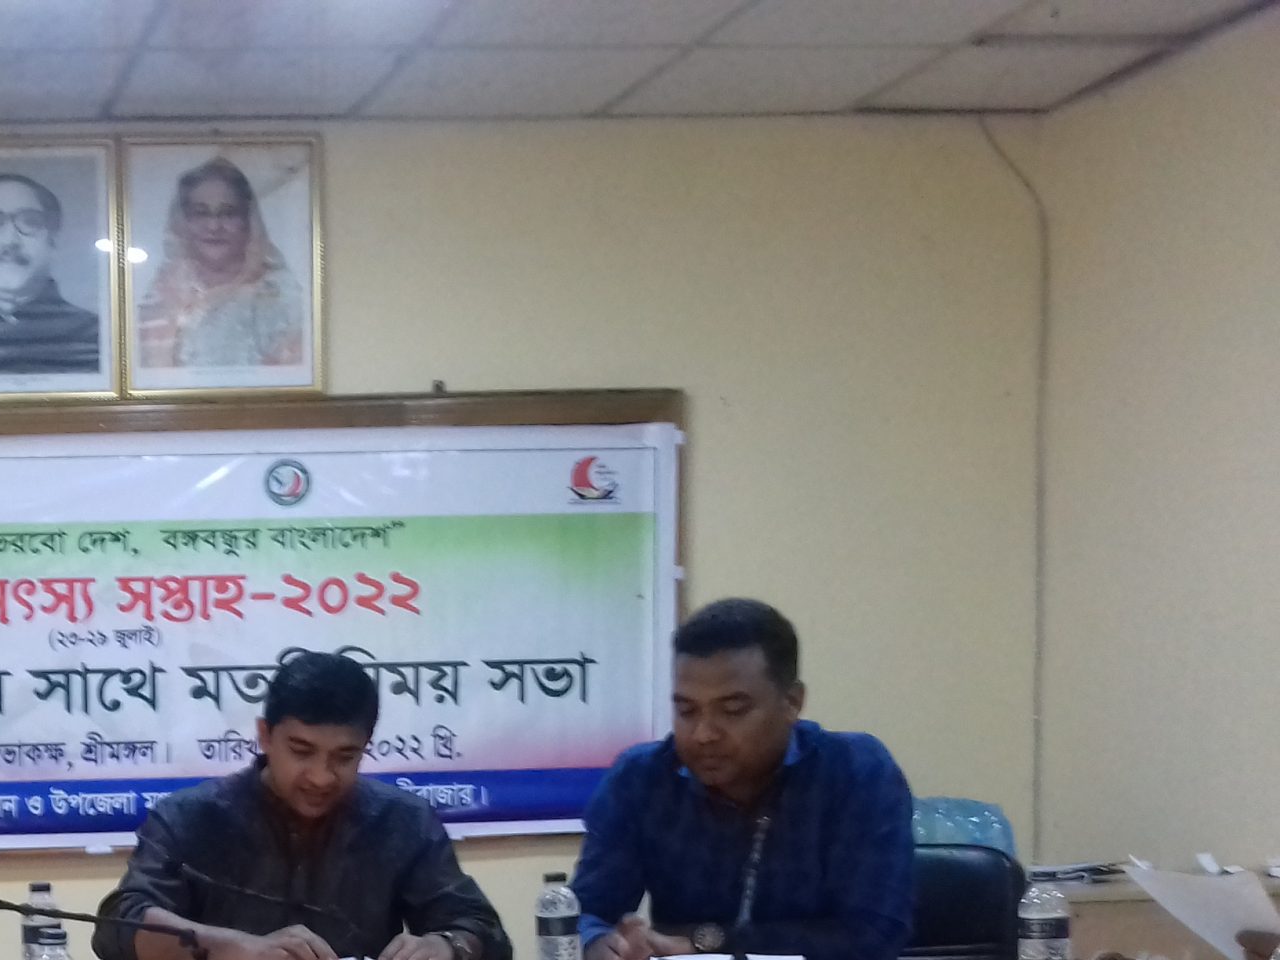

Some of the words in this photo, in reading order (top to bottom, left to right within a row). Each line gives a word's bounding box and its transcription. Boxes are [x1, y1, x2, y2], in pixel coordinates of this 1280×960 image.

[160, 528, 261, 558] বঙ্গবন্ধুর
[116, 571, 422, 622] সপ্তাহ-২০২২
[26, 661, 167, 715] সাথে
[481, 651, 598, 704] সভা
[26, 798, 46, 816] ও
[49, 786, 139, 816] উপজেলা
